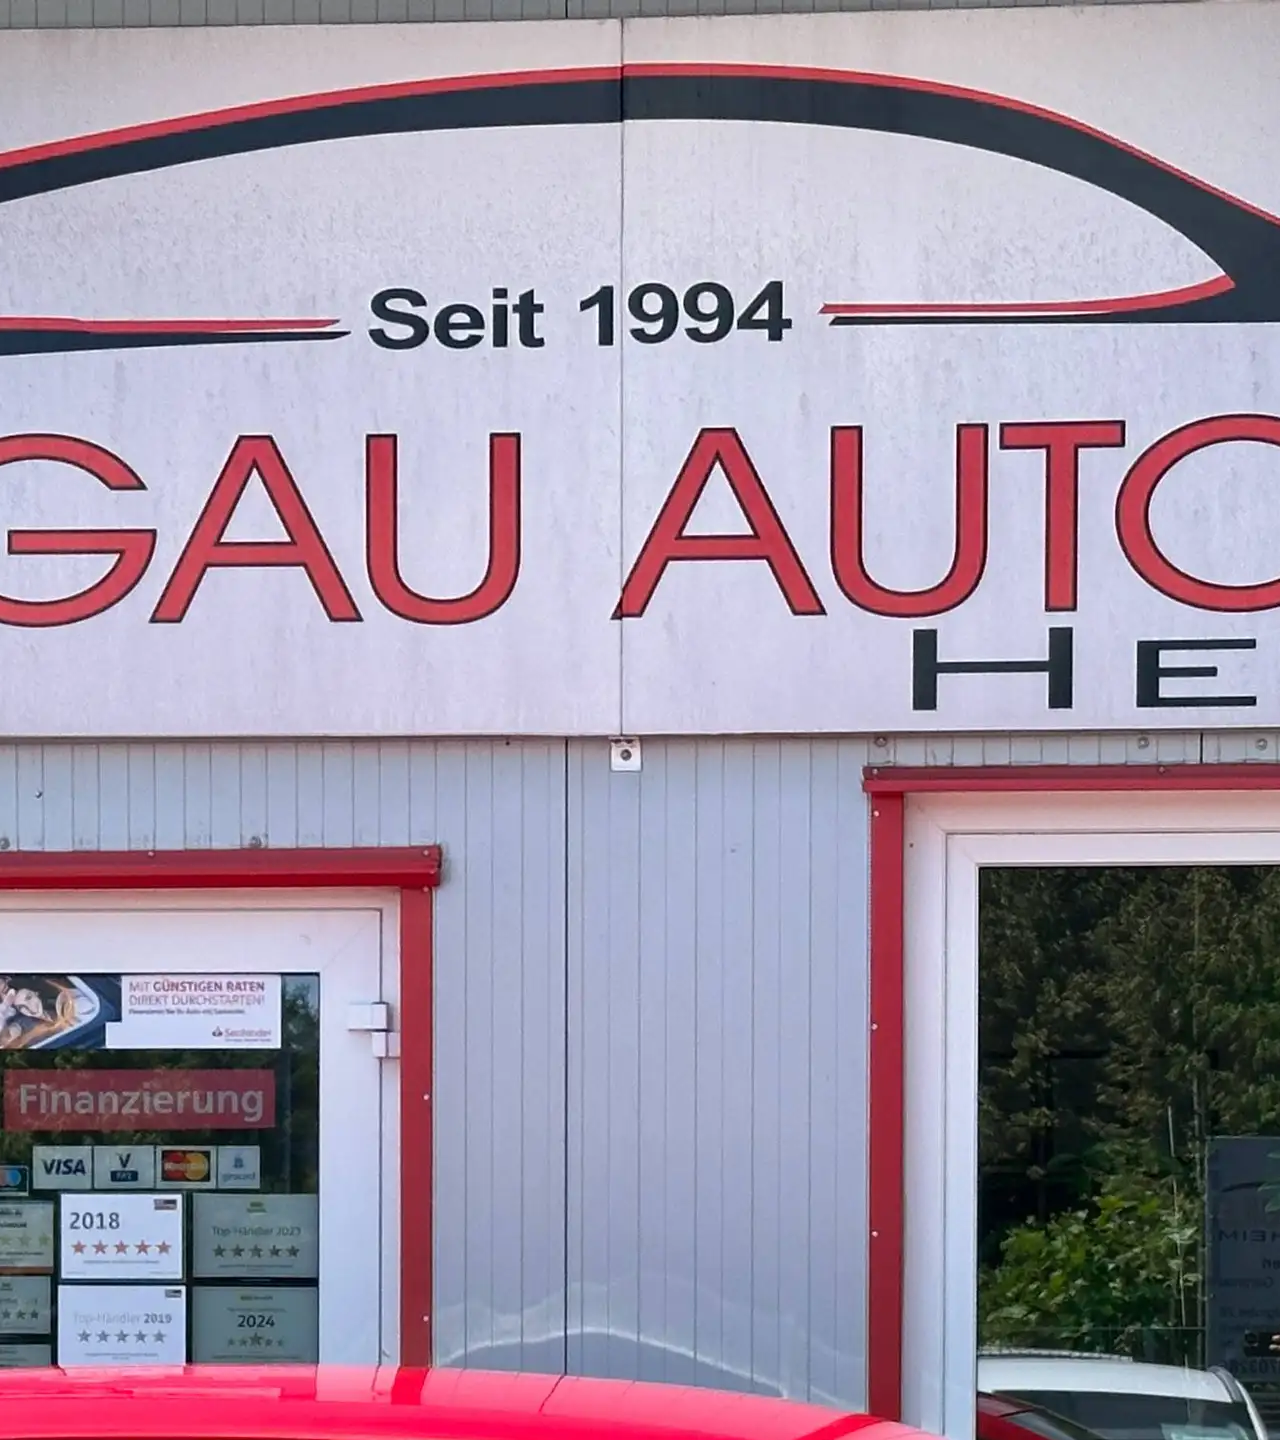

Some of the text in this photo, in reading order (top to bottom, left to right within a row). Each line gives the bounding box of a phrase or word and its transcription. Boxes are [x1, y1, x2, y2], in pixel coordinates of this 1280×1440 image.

[369, 280, 793, 349] Seit 1994
[128, 979, 265, 993] MIT GÜNSTIGEN RATEN
[19, 1081, 265, 1122] Finanzierung
[41, 1157, 86, 1176] VISA
[69, 1212, 120, 1230] 2018
[143, 1312, 172, 1325] 2019
[237, 1314, 275, 1328] 2024
